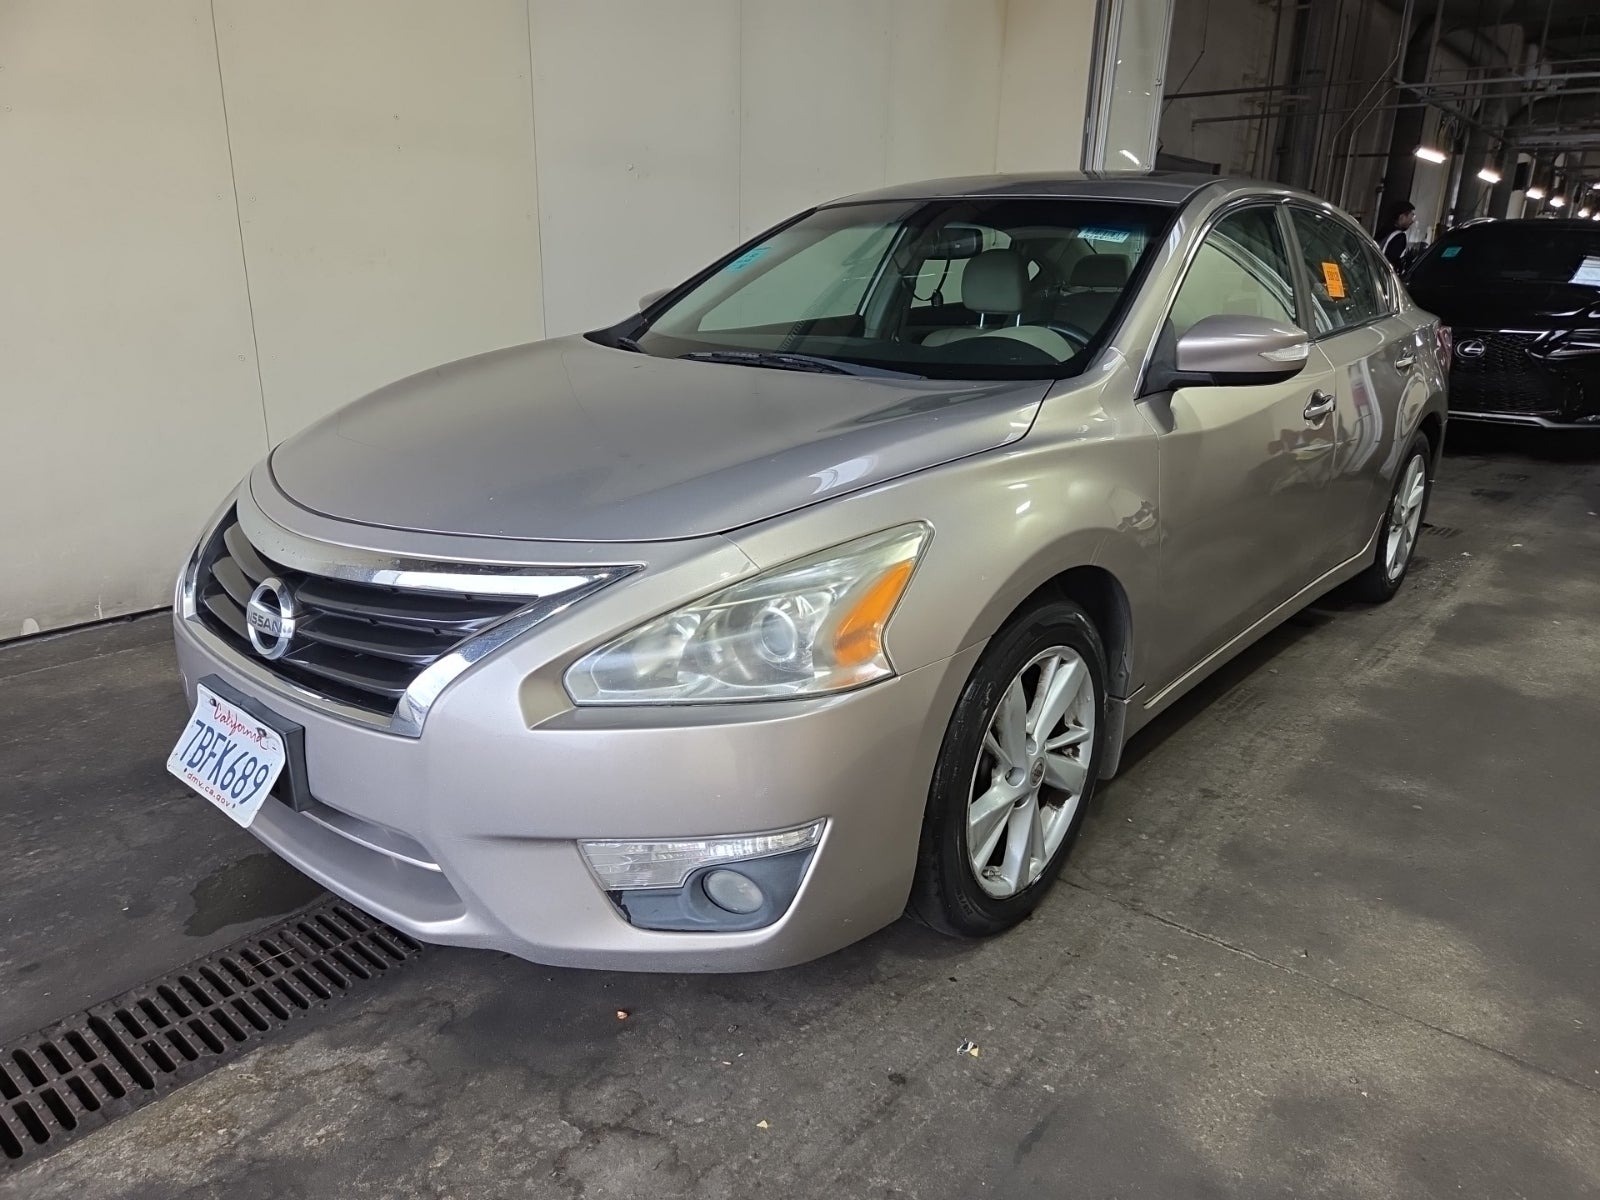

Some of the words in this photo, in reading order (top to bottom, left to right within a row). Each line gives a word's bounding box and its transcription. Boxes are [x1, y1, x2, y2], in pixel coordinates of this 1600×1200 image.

[247, 609, 282, 633] NISSAN
[213, 703, 267, 750] California
[180, 719, 269, 804] 7BFK689
[187, 773, 230, 807] dmv.ca.gov
